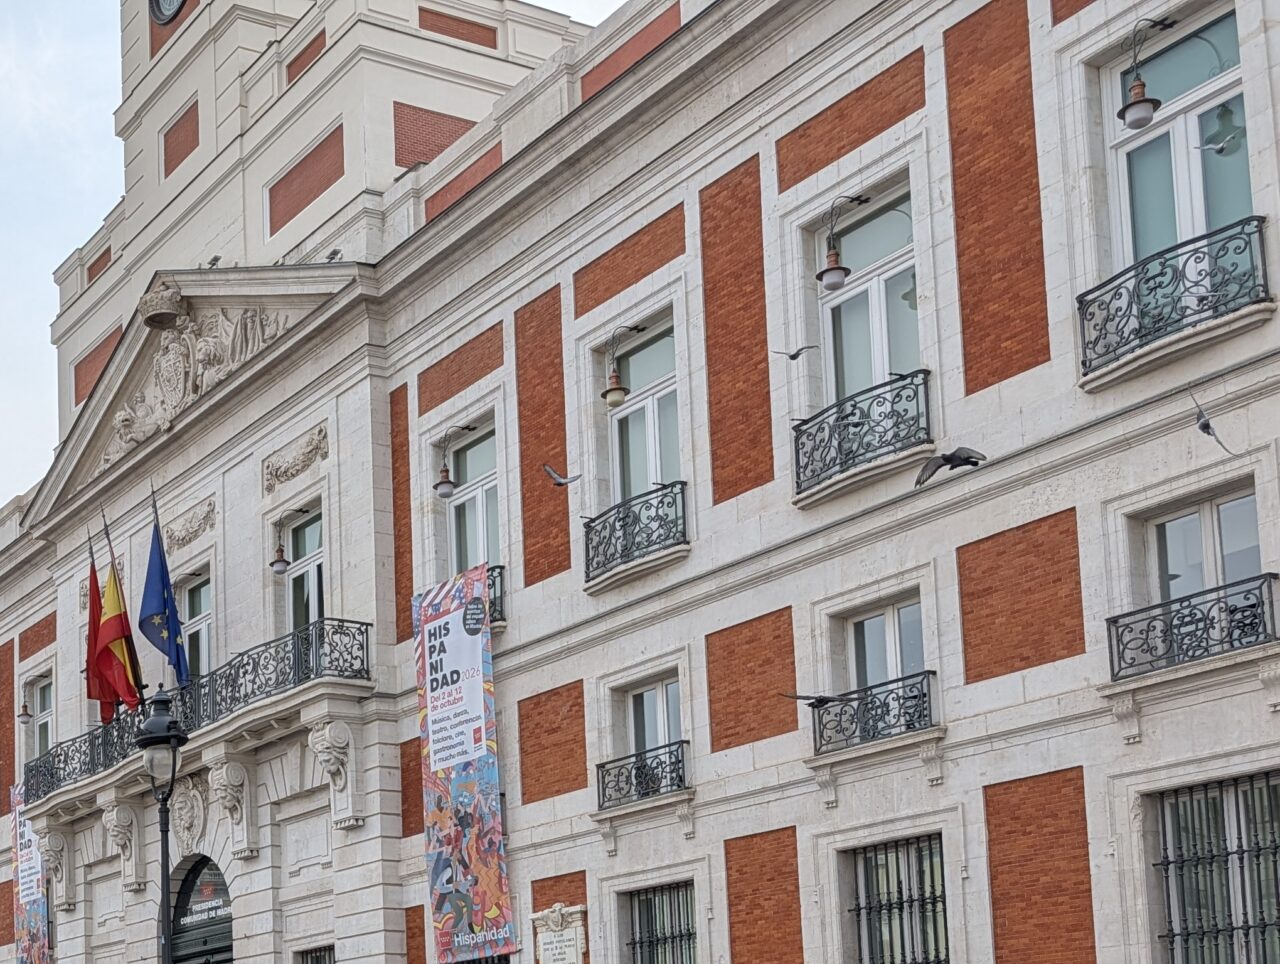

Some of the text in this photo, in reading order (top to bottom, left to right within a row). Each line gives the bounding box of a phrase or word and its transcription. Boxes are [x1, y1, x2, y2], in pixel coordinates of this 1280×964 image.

[428, 621, 450, 643] HIS
[429, 640, 447, 660] PA
[429, 658, 443, 676] NI
[430, 669, 460, 694] DAD
[430, 693, 440, 704] Del
[431, 695, 463, 712] de octubre
[454, 924, 510, 946] Hispanidad
